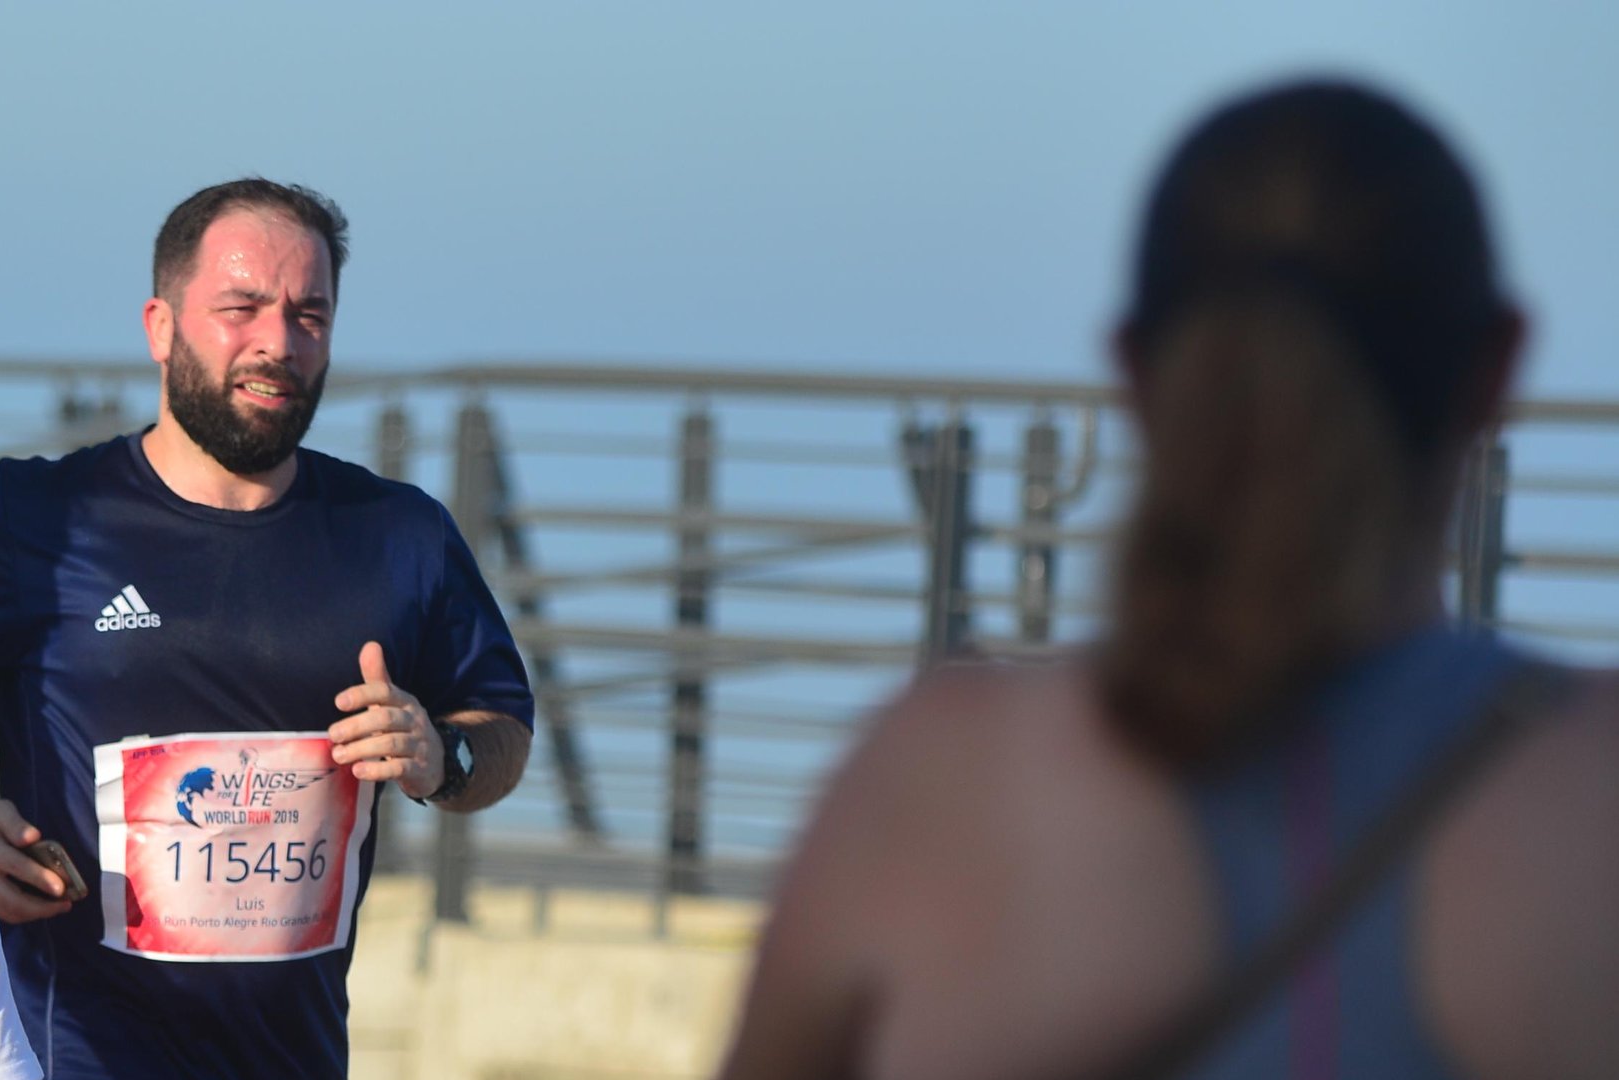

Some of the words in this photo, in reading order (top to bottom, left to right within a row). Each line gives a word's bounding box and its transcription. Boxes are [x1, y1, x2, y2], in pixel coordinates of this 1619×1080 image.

[94, 612, 162, 632] adidas
[222, 769, 297, 790] WINGS
[232, 790, 276, 807] LIFE
[204, 810, 246, 825] WORLD
[247, 809, 271, 825] RUN
[273, 809, 300, 825] 2019
[166, 839, 327, 883] 115456
[236, 896, 265, 911] Luis
[190, 916, 221, 928] Porto
[222, 916, 257, 931] Alegre
[261, 916, 278, 927] Rio
